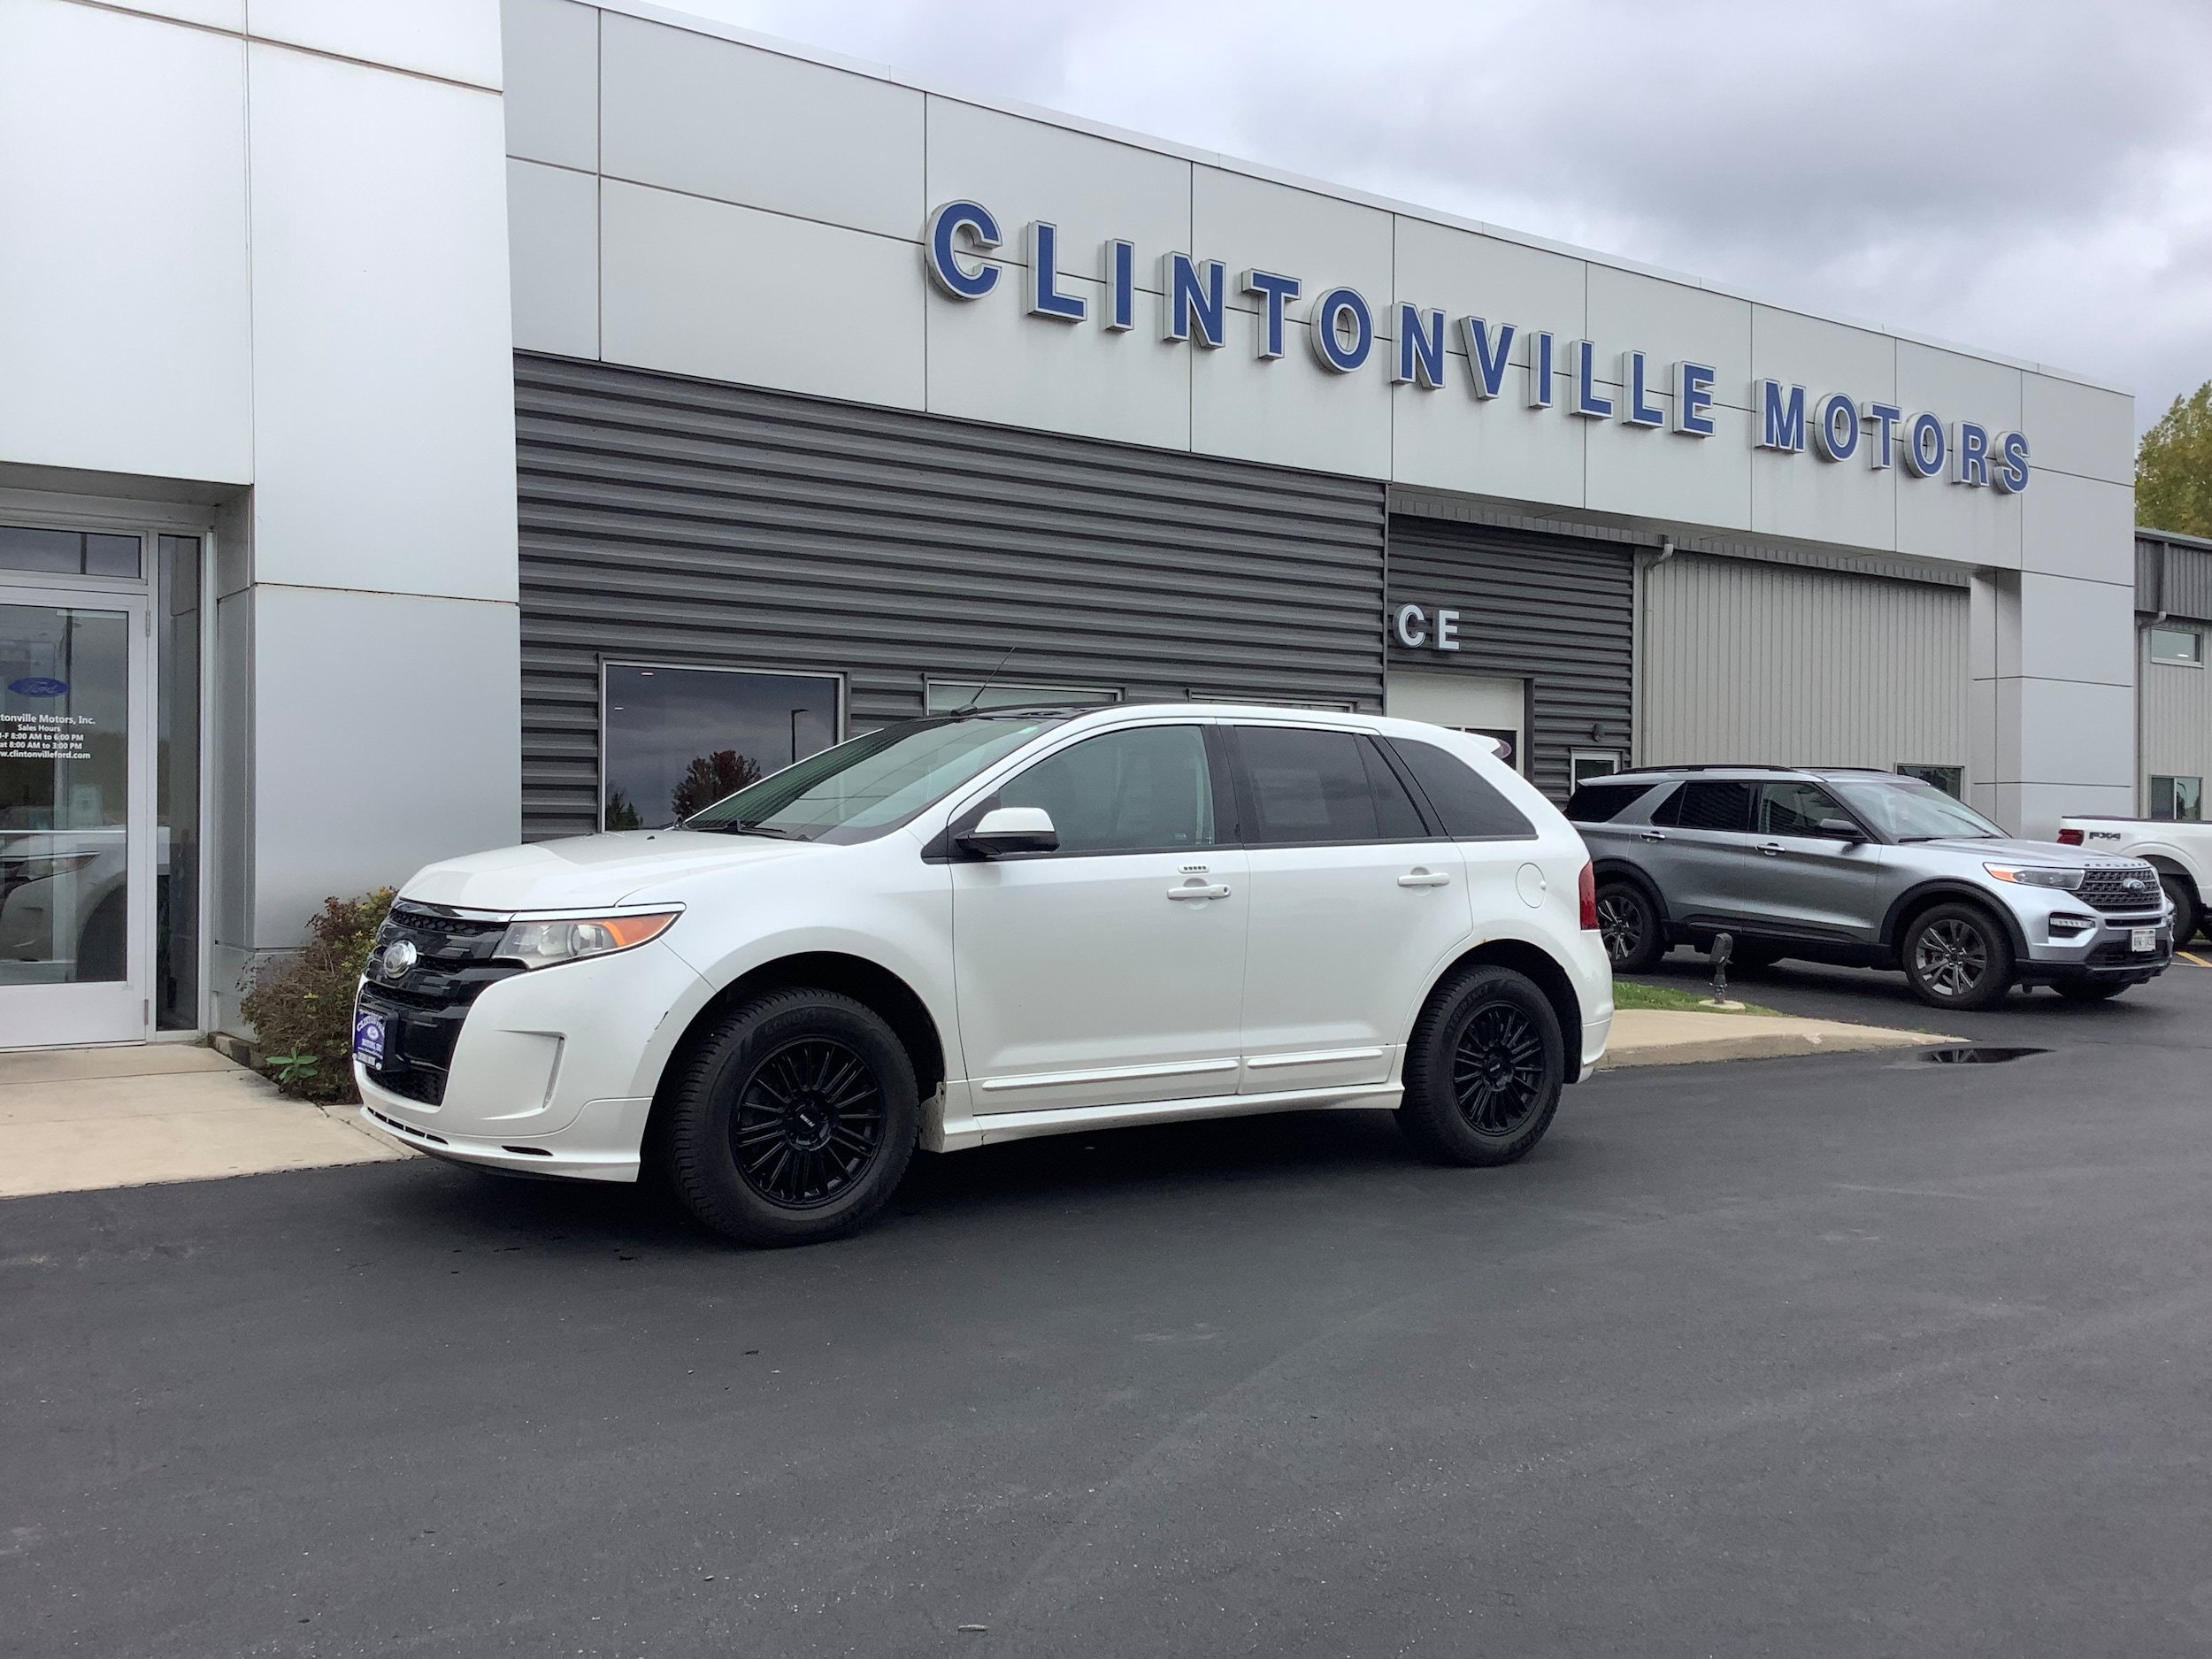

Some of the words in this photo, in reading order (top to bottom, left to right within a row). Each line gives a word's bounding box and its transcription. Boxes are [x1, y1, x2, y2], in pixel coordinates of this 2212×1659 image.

[926, 199, 1716, 437] CLINTONVILLE
[1755, 378, 2031, 495] MOTORS
[1393, 603, 1460, 650] CE
[27, 680, 58, 694] Ford
[39, 715, 76, 725] Motors,
[2089, 832, 2121, 841] FX4
